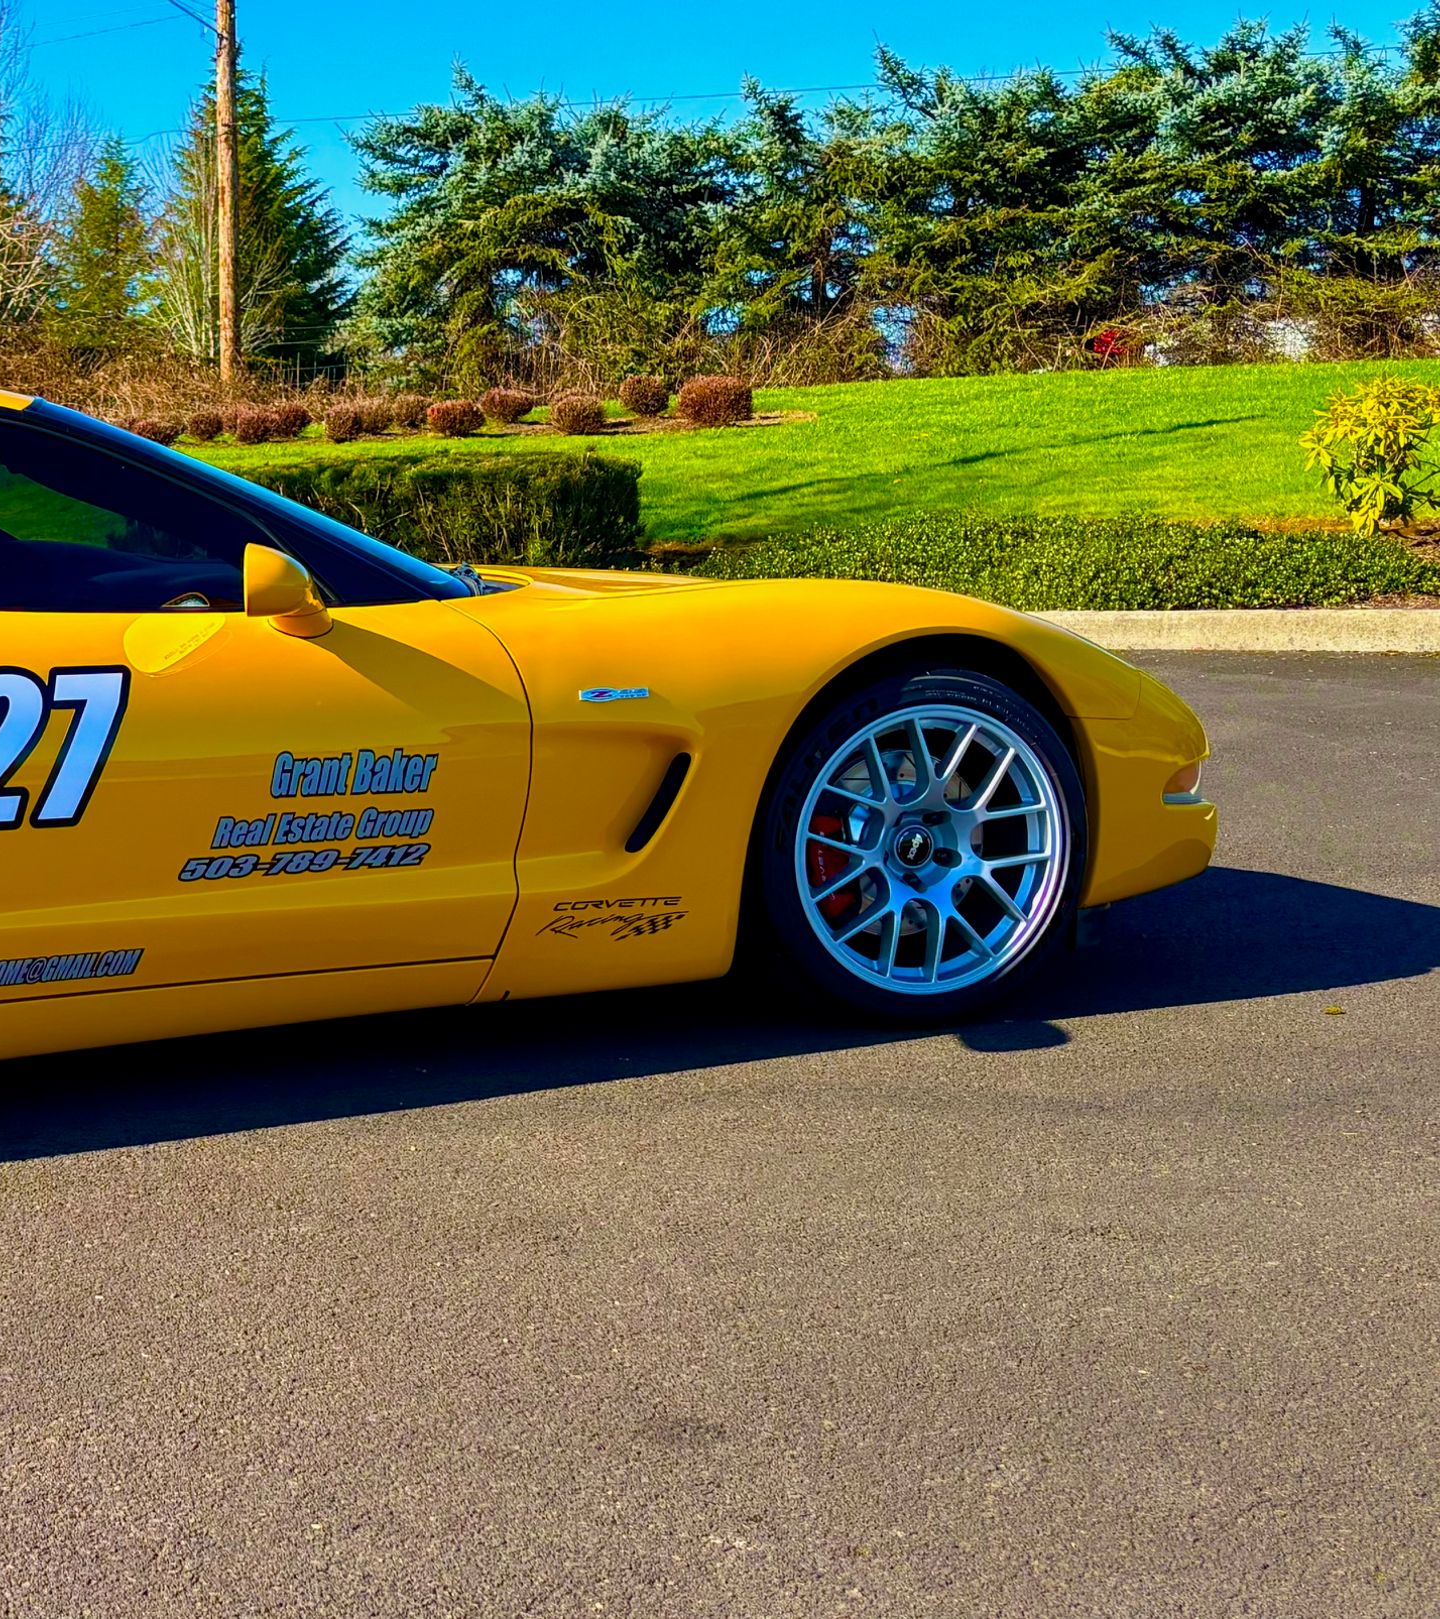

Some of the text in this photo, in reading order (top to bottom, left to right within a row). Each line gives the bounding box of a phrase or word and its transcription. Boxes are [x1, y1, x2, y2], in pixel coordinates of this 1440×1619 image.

[270, 748, 439, 799] Grant Baker
[210, 806, 435, 850] Real Estate Group
[177, 843, 432, 882] 503-789-7412
[553, 896, 682, 911] CORVETTE
[535, 911, 689, 939] Racing
